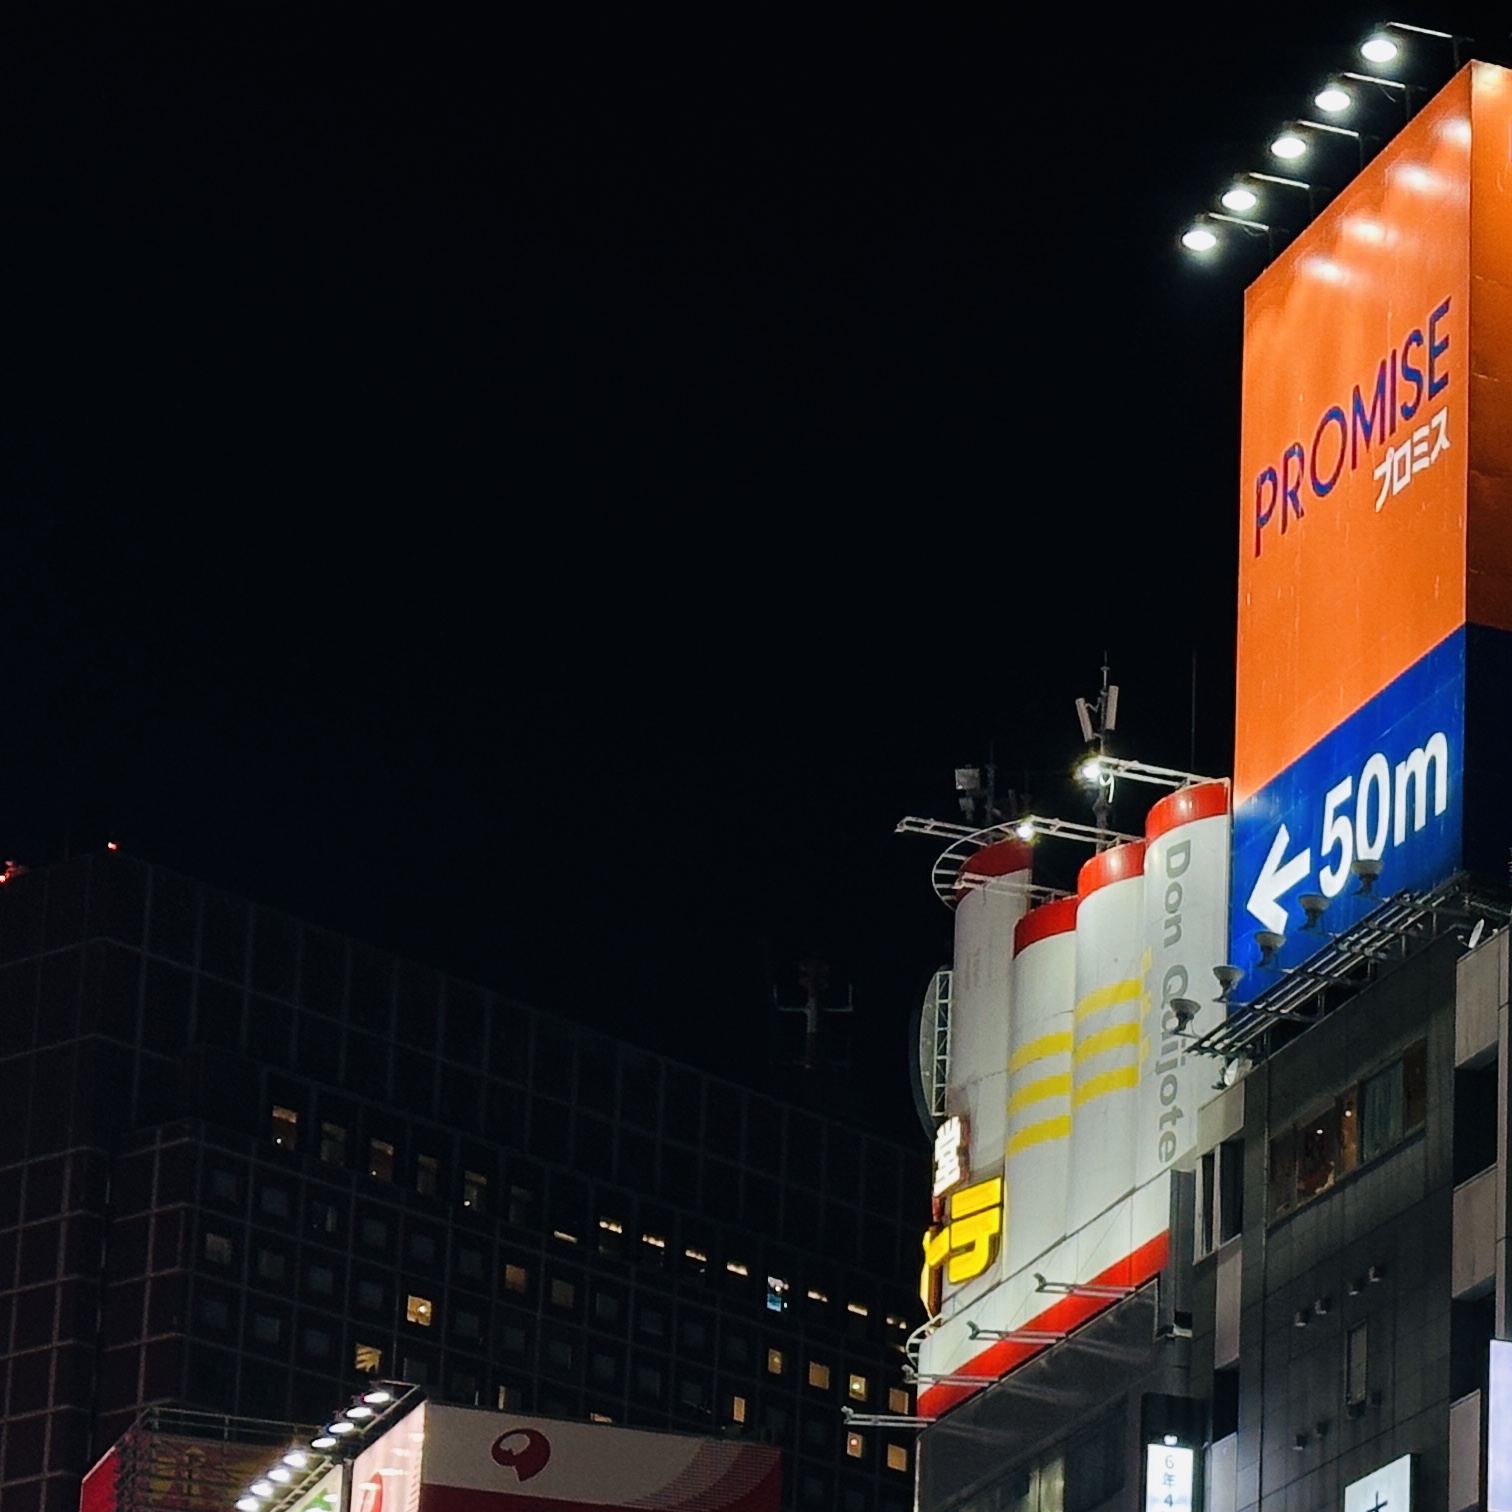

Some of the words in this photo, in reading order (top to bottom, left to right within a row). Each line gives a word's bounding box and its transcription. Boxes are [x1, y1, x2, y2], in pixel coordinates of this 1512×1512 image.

[1254, 295, 1453, 559] PROMISE
[1373, 404, 1452, 513] プロミス
[1319, 730, 1449, 899] 50m
[1162, 838, 1193, 952] Don
